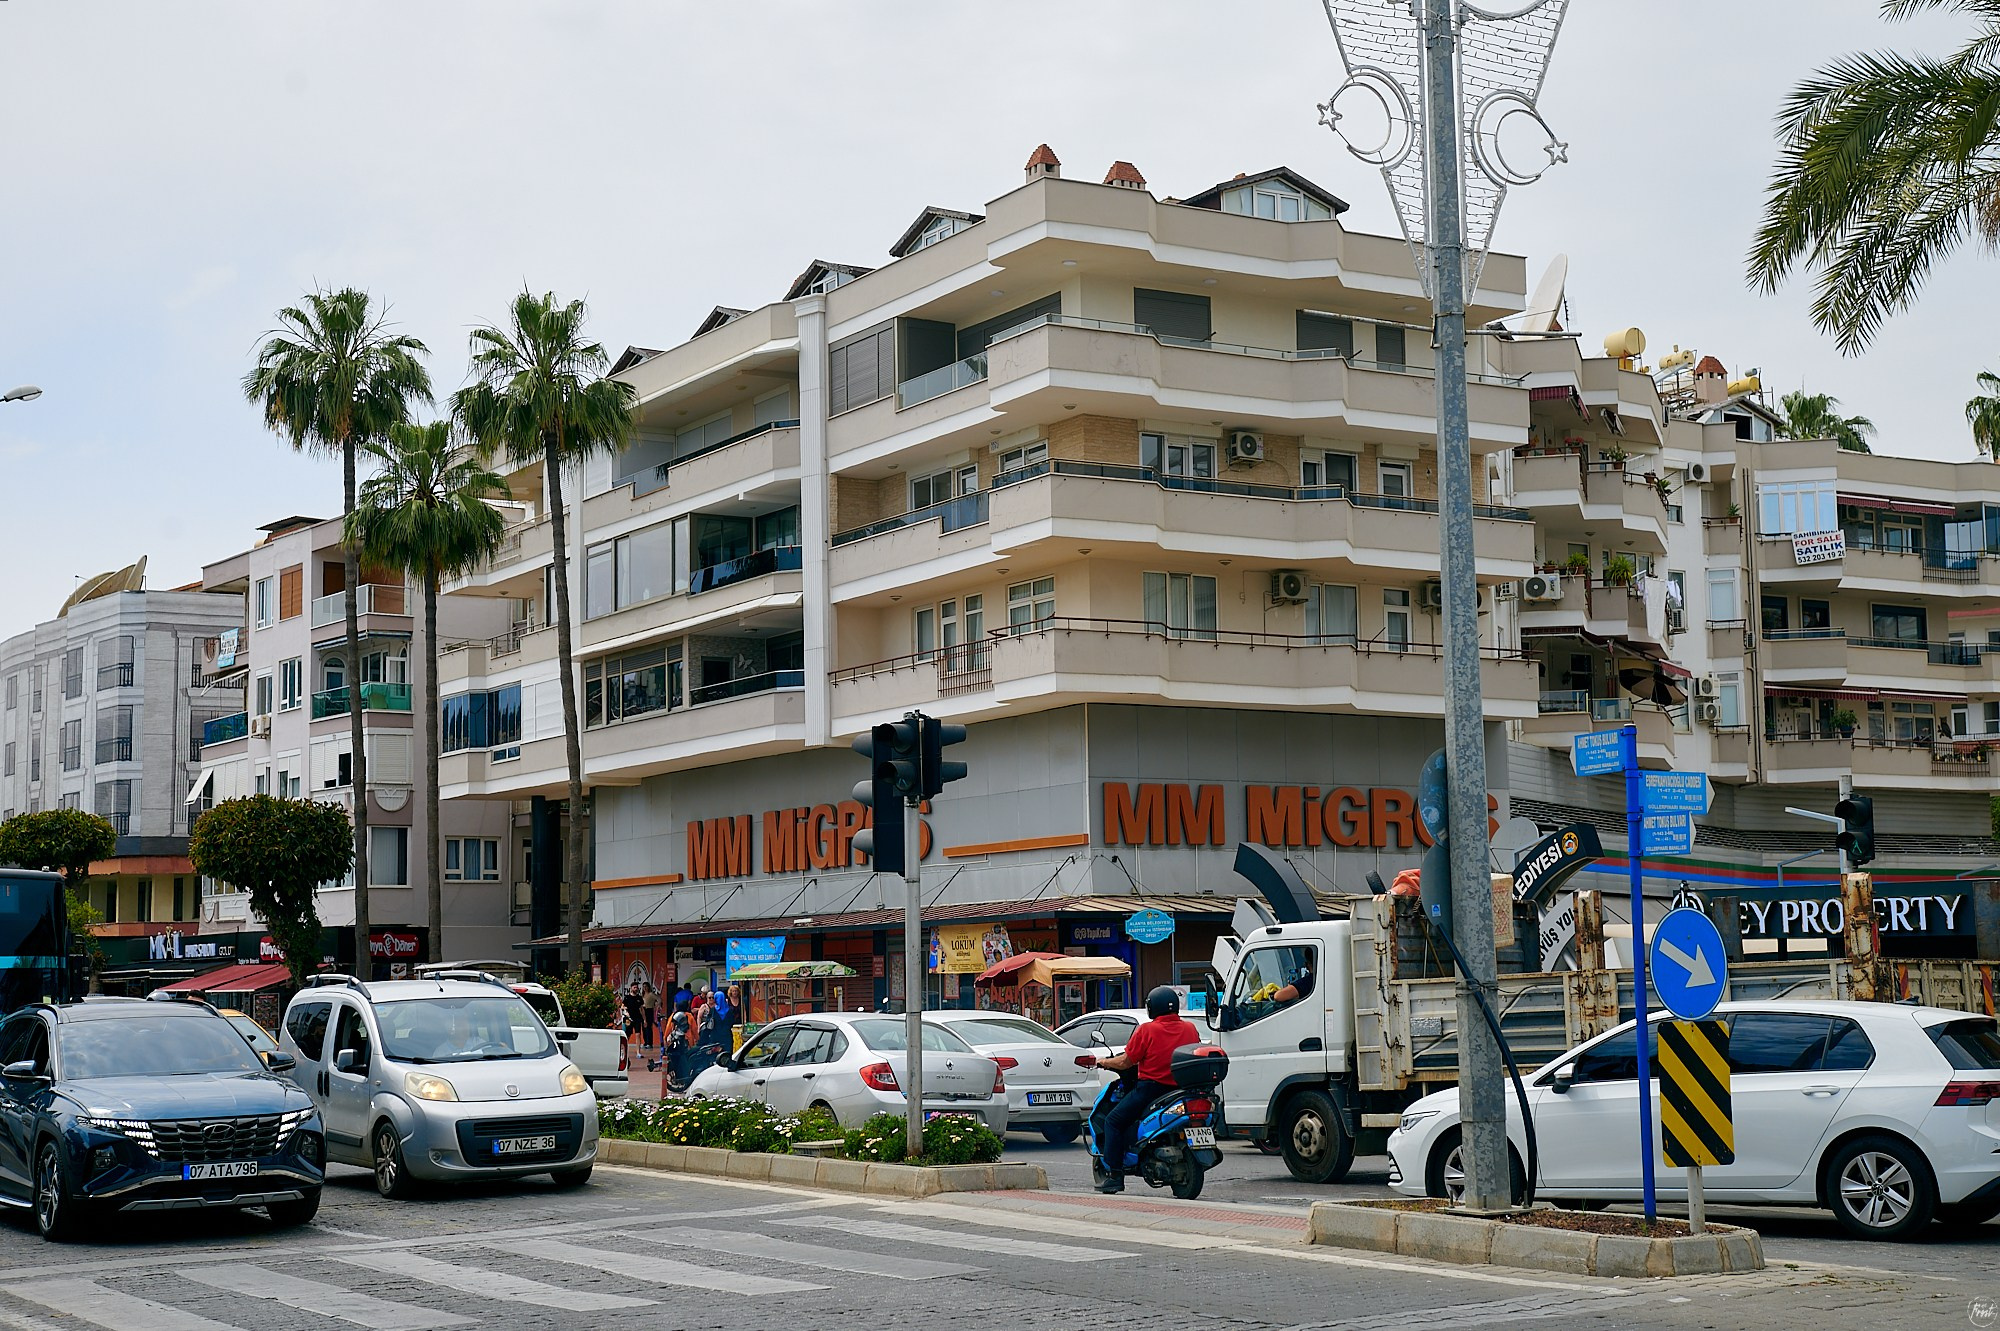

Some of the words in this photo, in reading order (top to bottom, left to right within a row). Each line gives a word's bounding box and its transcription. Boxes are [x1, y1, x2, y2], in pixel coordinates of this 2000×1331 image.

[1795, 539, 1814, 547] FOR
[1817, 534, 1841, 544] SALE
[1796, 542, 1843, 556] SATILIK
[1812, 553, 1826, 561] 203
[1578, 736, 1590, 749] AHMET
[1602, 731, 1619, 746] BULVARI
[1103, 782, 1225, 845] MM
[1644, 816, 1656, 829] AHMET
[1670, 814, 1686, 828] BULVARI
[687, 814, 752, 881] MM
[1512, 839, 1563, 901] EDİYESİ
[1780, 894, 1961, 934] PROERTY
[219, 946, 232, 956] GOLD
[394, 940, 417, 953] Döner
[951, 939, 975, 951] LOKUM
[1032, 1094, 1041, 1103] 07
[1186, 1129, 1196, 1137] 31
[1197, 1128, 1212, 1136] ANG
[498, 1140, 512, 1152] 07
[514, 1137, 538, 1151] NZE
[541, 1136, 555, 1149] 36
[190, 1165, 205, 1179] 07
